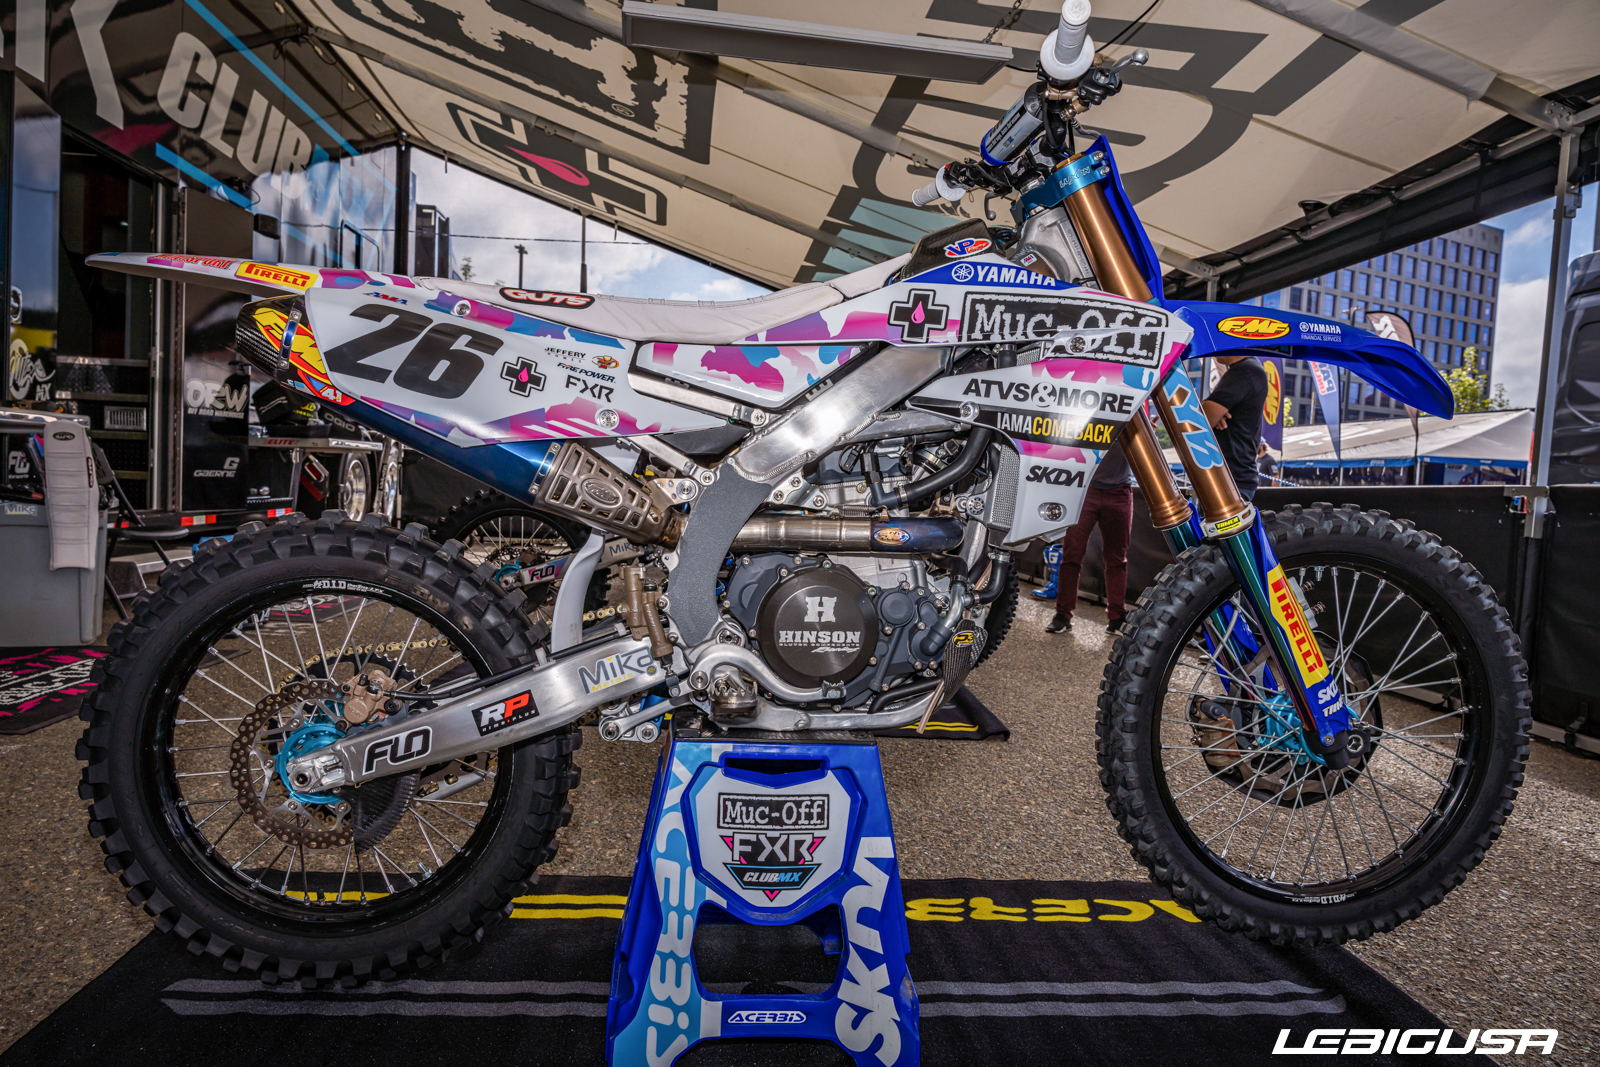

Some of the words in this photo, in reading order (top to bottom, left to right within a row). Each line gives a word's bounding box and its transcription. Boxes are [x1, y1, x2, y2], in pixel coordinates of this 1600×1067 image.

[245, 263, 311, 288] PIRELLI
[976, 265, 1057, 287] YAMAHA
[503, 288, 591, 306] GUTS
[972, 304, 1158, 355] Muc-Off
[1218, 319, 1290, 334] FMF
[1308, 323, 1342, 335] YAMAHA
[1323, 335, 1342, 343] SERVICES
[323, 303, 505, 399] 26
[544, 347, 586, 359] JEFFERY
[565, 374, 615, 403] FXR
[963, 378, 1134, 415] ATVS&MORE
[323, 412, 356, 432] OGIO
[530, 564, 555, 582] FLO
[804, 596, 837, 622] H
[779, 630, 860, 643] HINSON
[1271, 575, 1323, 673] PIRELLI
[578, 646, 654, 695] Mika
[592, 673, 634, 692] Metals
[480, 693, 530, 728] RP
[512, 709, 536, 722] PLUS
[364, 728, 430, 774] FLO
[725, 799, 823, 825] Muc-Off
[732, 833, 813, 862] FXR
